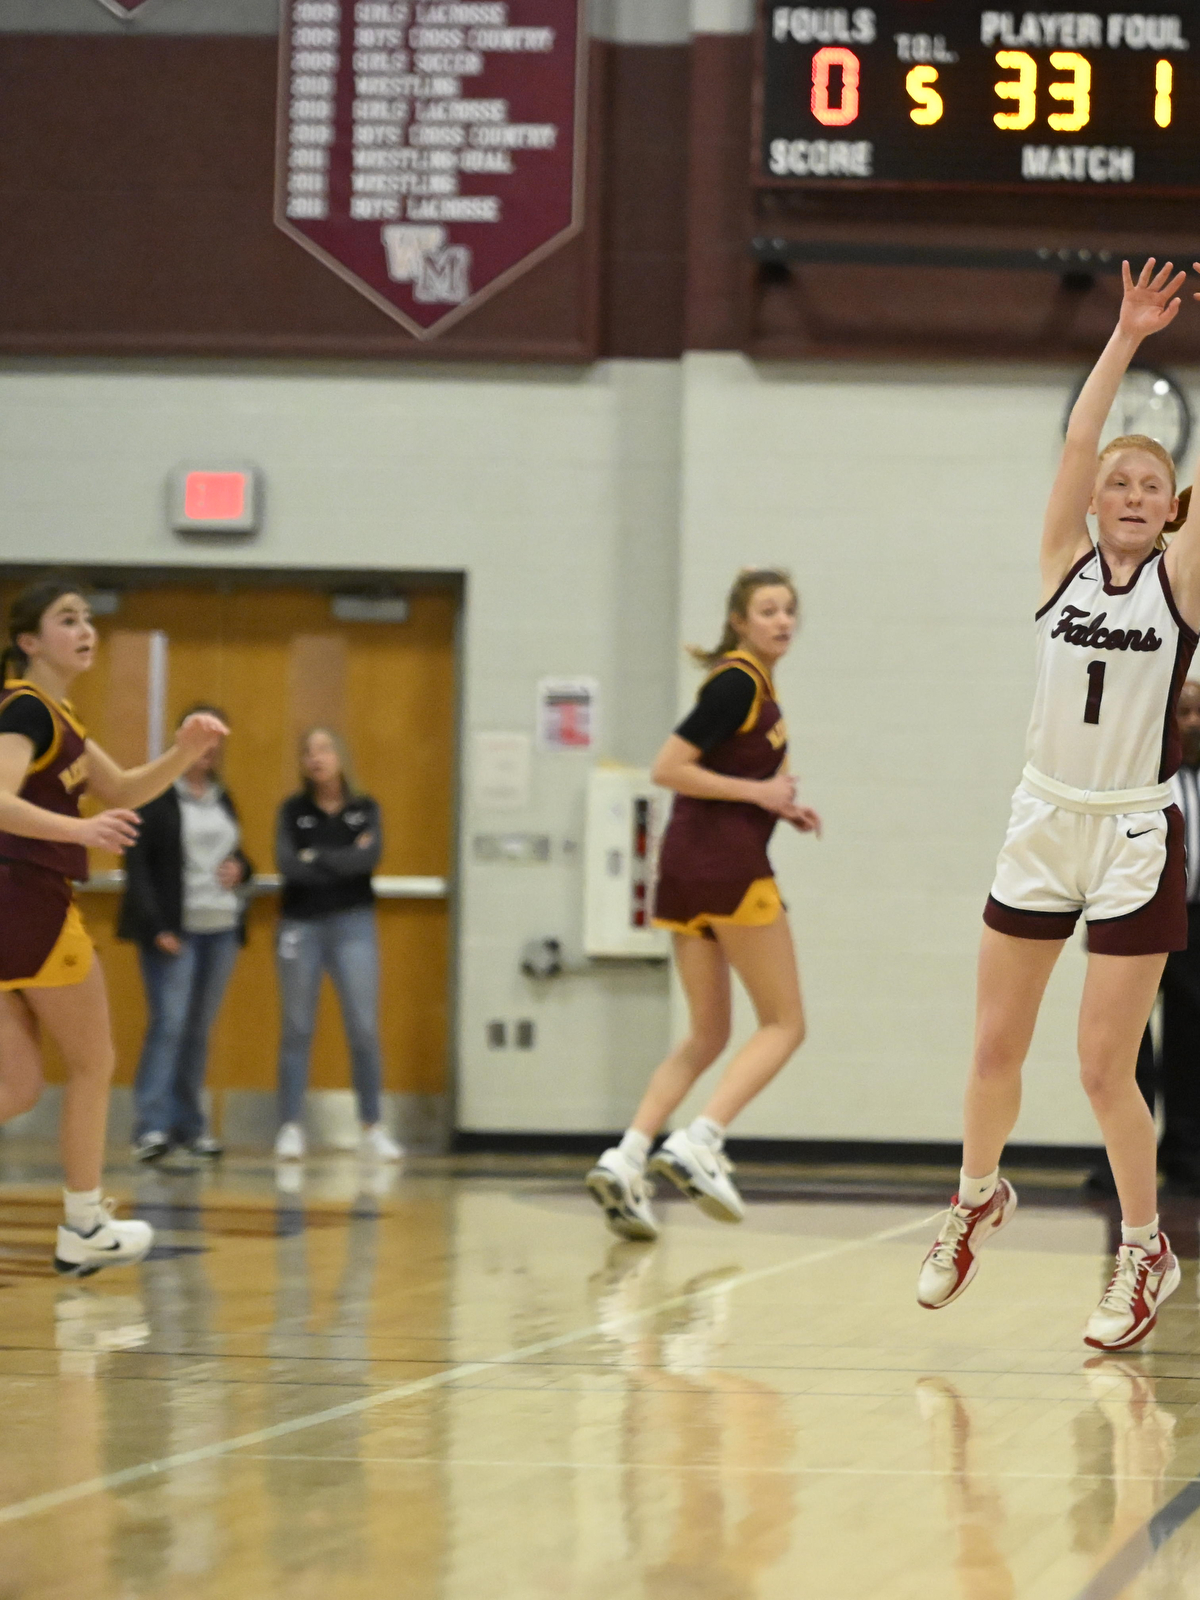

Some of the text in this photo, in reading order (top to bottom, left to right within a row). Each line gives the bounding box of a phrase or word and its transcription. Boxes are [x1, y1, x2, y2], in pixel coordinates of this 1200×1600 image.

[415, 2, 507, 25] LACROSSE
[772, 6, 876, 44] FOULS
[980, 10, 1190, 51] PLAYER FOUL
[409, 26, 465, 50] CROSS
[467, 26, 554, 51] COUNTRY
[355, 75, 461, 98] WRESTLING
[811, 47, 860, 126] 0
[905, 64, 943, 126] 5
[993, 51, 1173, 131] 33 1
[415, 99, 508, 122] LACROSSE
[409, 123, 466, 147] CROSS
[468, 123, 557, 148] COUNTRY
[351, 148, 459, 171] WRESTLING
[769, 137, 873, 177] SCORE
[1021, 144, 1135, 182] MATCH
[351, 172, 459, 195] WRESTLING
[406, 196, 500, 222] LACROSSE
[1051, 604, 1162, 653] Falcons
[1083, 660, 1106, 725] 1
